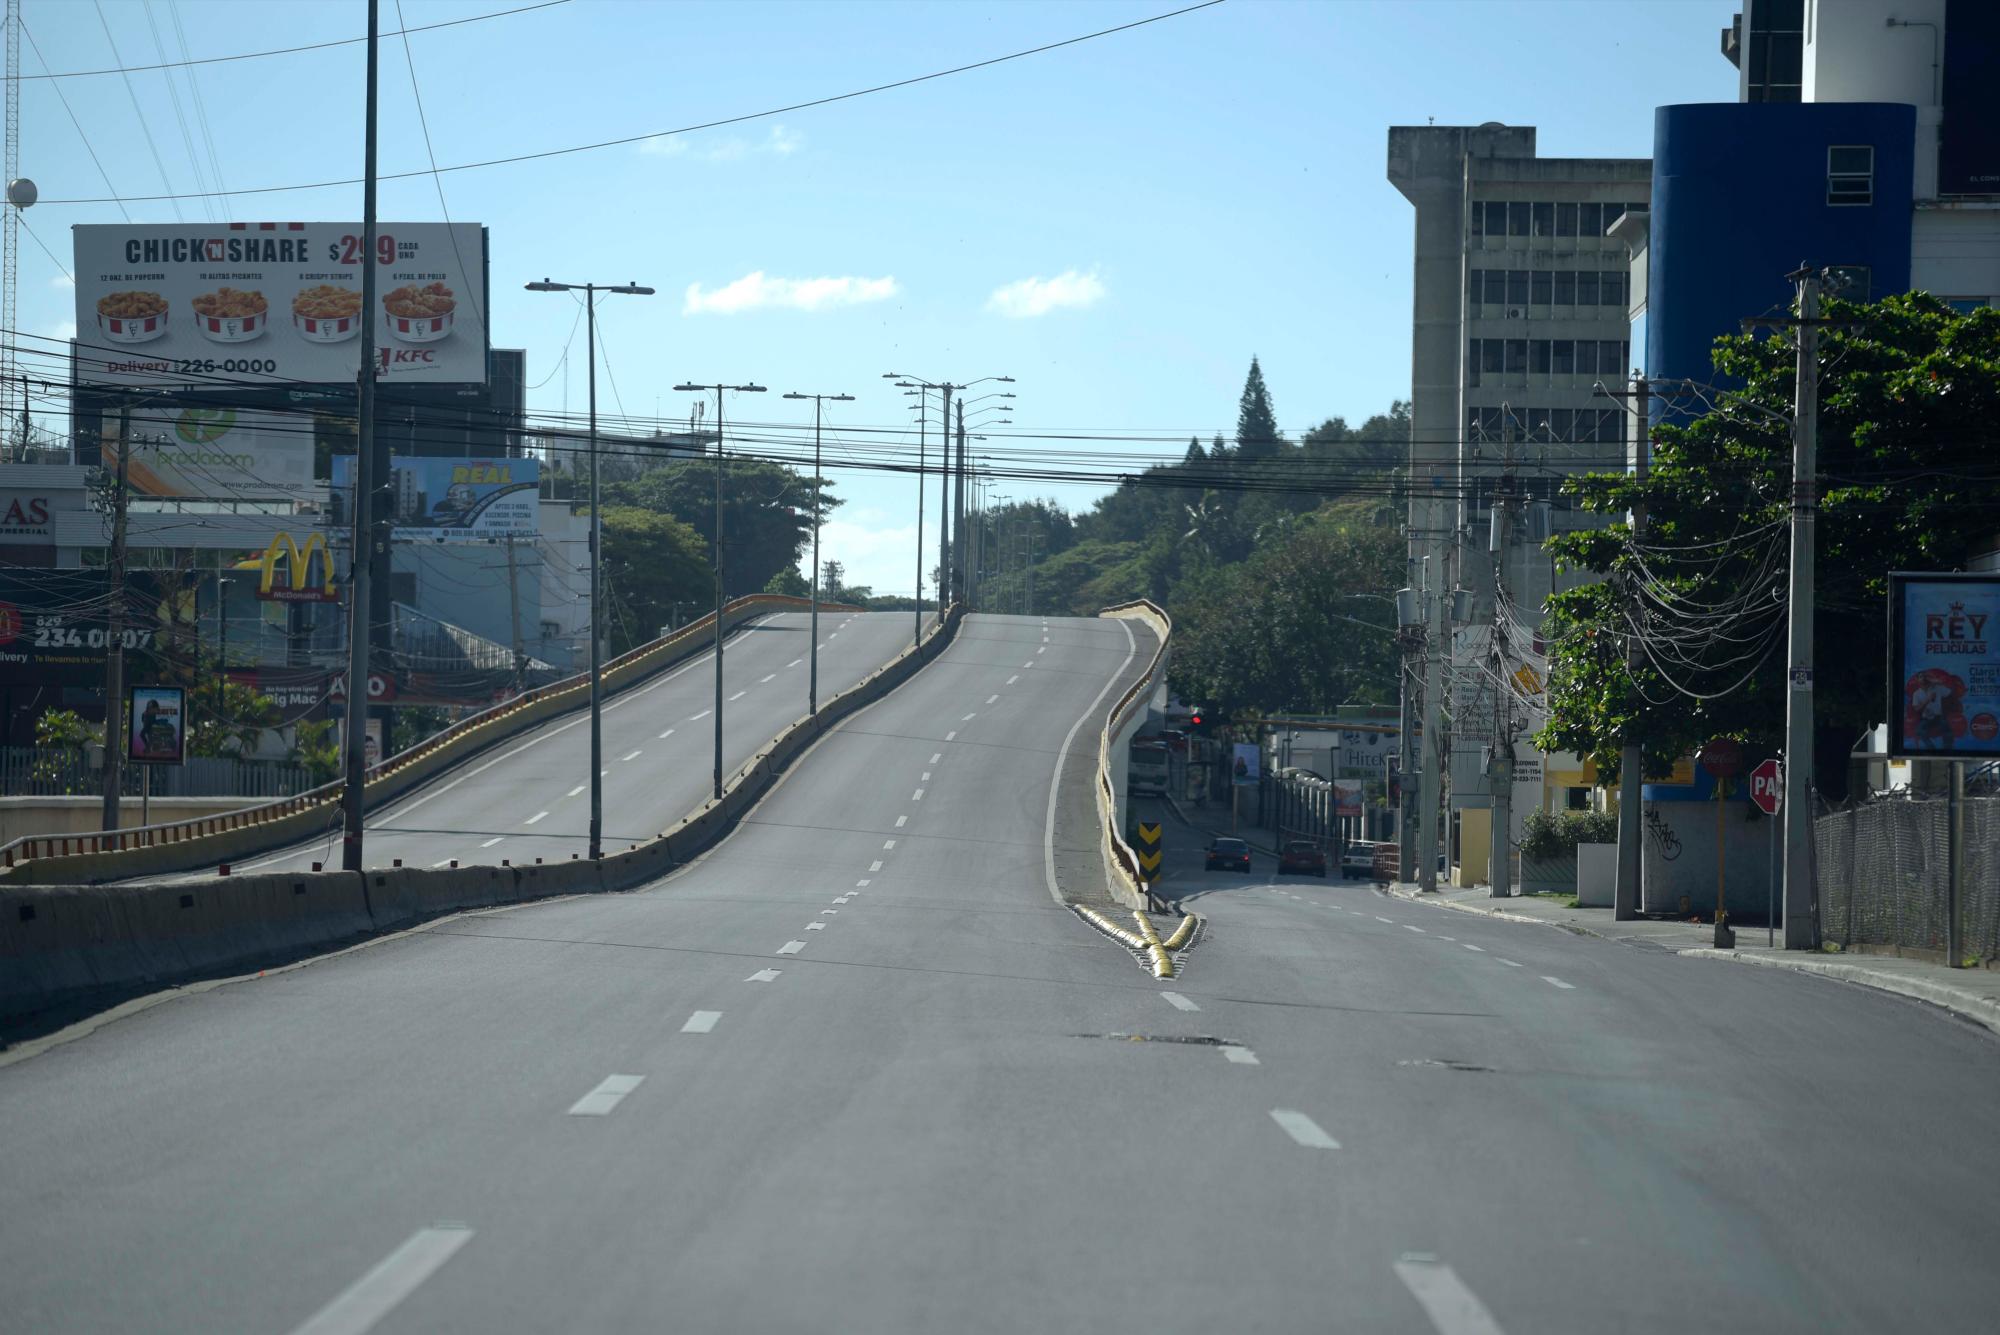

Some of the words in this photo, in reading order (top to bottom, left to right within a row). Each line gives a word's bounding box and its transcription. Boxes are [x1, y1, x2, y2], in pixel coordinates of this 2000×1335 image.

[126, 239, 207, 263] CHICK
[228, 239, 309, 263] SHARE
[398, 242, 419, 250] CADA
[398, 251, 415, 260] UNO
[394, 350, 435, 363] KFC
[107, 360, 170, 374] Delivery
[180, 359, 277, 373] 226-0000
[155, 447, 255, 468] prodacom
[452, 464, 513, 484] REAL
[1, 498, 49, 524] AS
[273, 591, 322, 600] McDonald's
[36, 615, 62, 627] 829
[1926, 614, 1987, 639] REY
[34, 628, 82, 648] 234
[1925, 644, 1987, 654] PELICULAS
[34, 656, 43, 664] Te
[44, 655, 81, 664] llevamos
[290, 693, 318, 705] Mac
